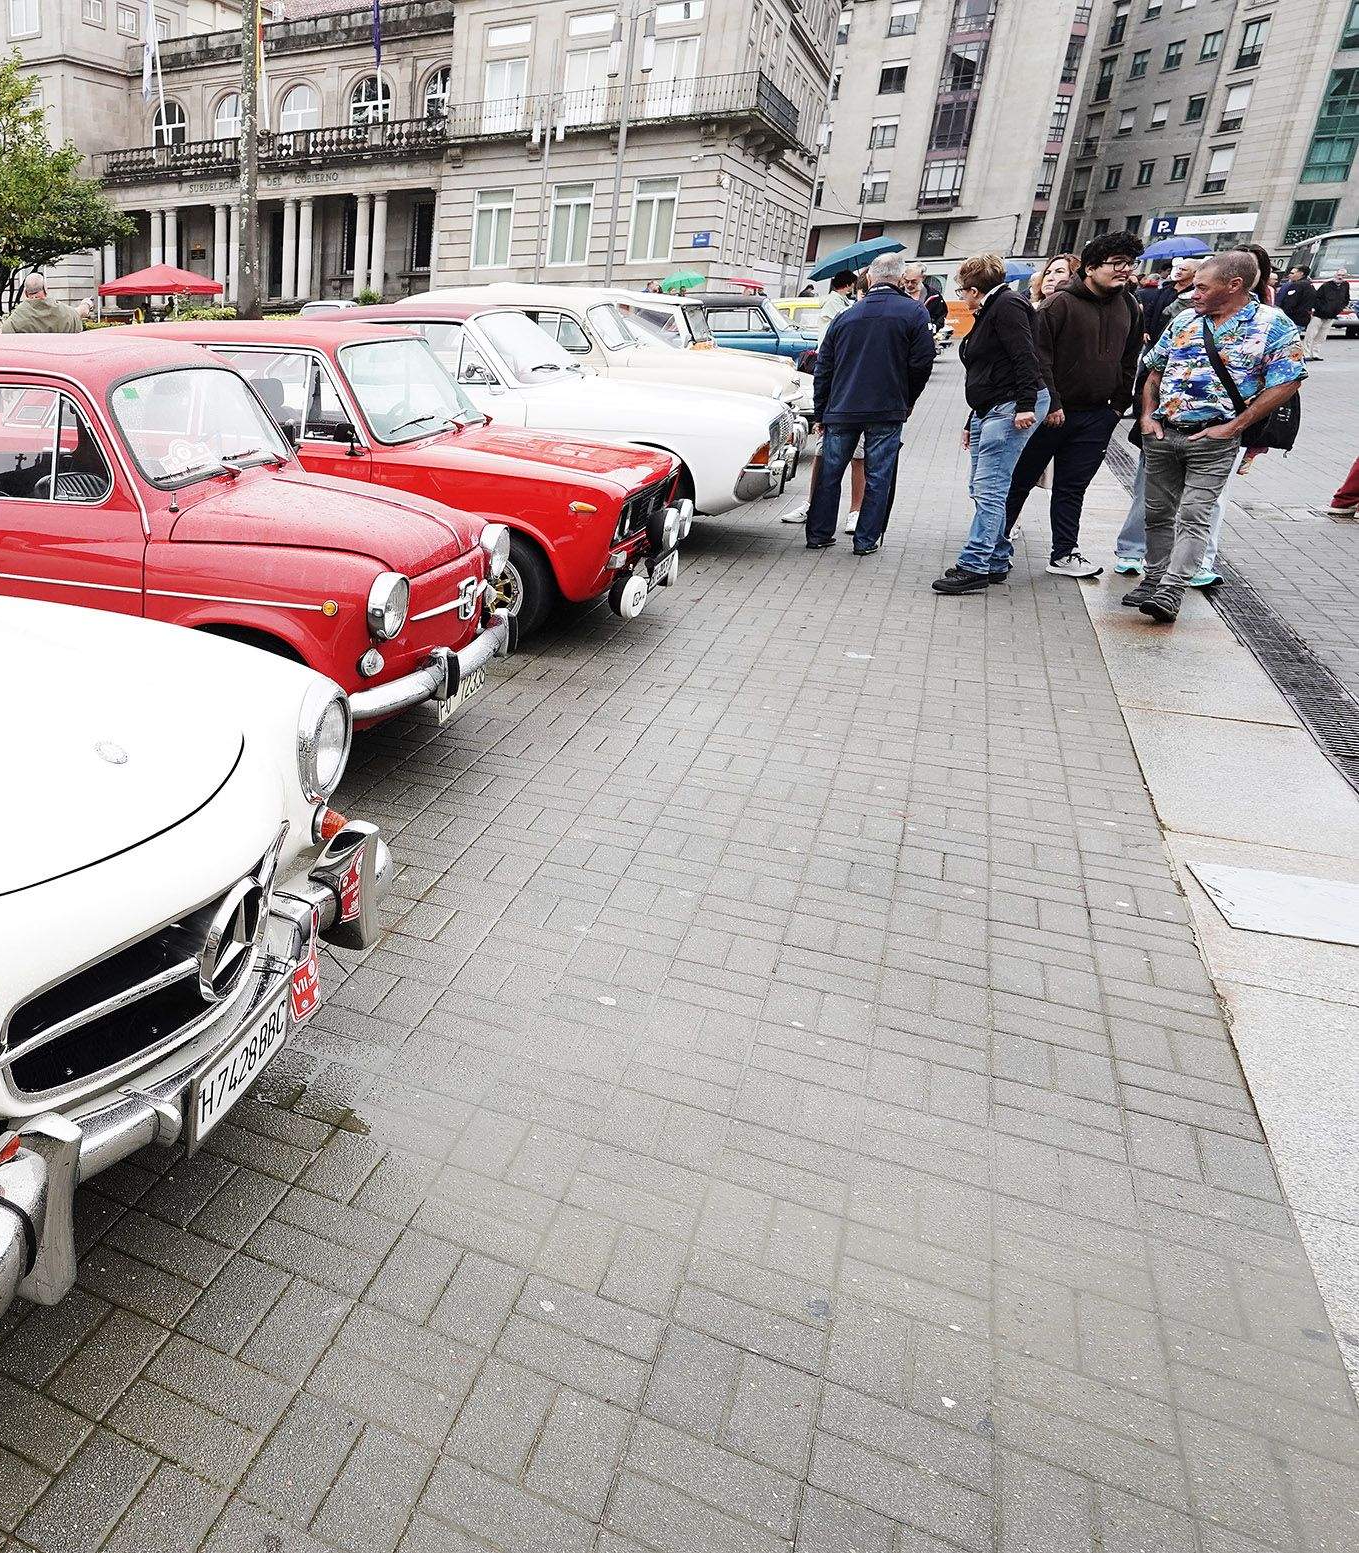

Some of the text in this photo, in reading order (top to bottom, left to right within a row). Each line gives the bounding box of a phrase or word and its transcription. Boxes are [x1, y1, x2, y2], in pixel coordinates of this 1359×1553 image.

[189, 172, 339, 194] SUBDELEGAC DEL GOBIERNO
[1186, 217, 1228, 229] telpark
[200, 1000, 286, 1124] H7428BBC
